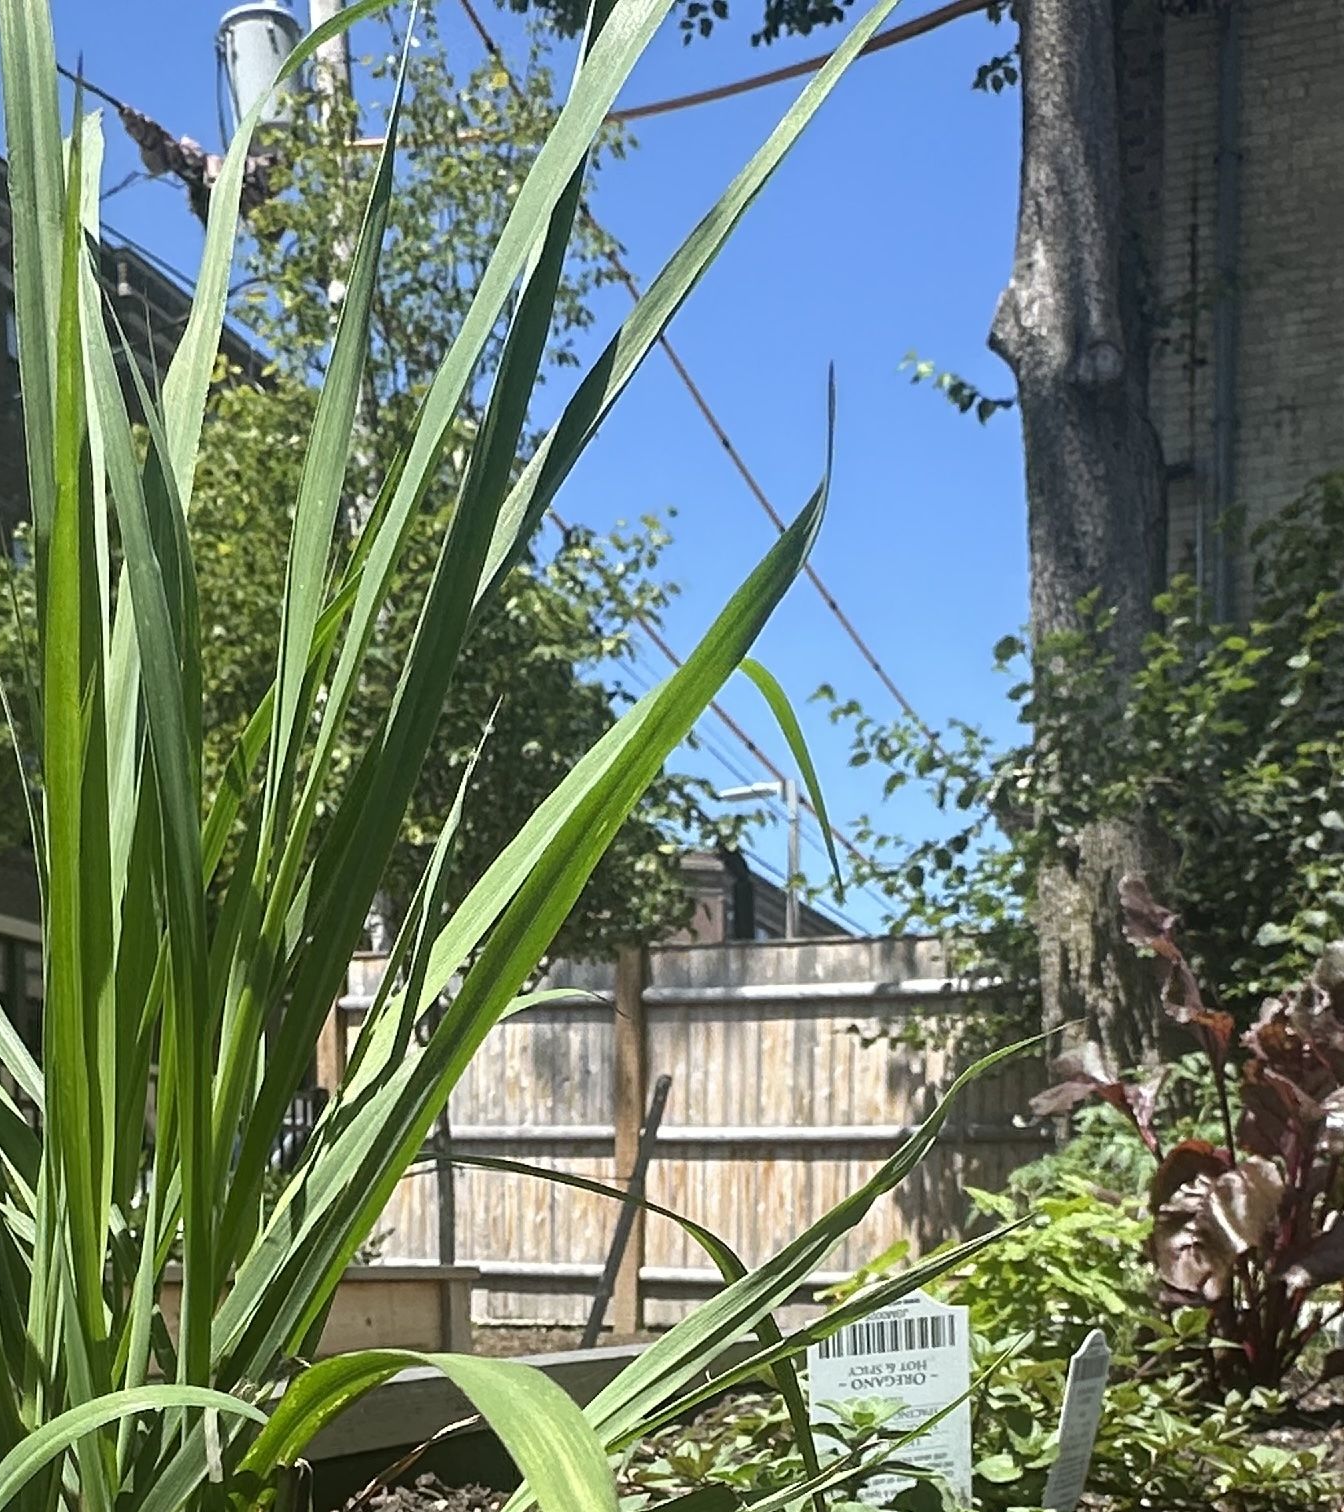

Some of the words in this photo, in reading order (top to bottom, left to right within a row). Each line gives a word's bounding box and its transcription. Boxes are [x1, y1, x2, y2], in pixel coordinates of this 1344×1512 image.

[849, 1364, 883, 1376] SPICY
[885, 1363, 896, 1373] &
[900, 1360, 927, 1373] HOT
[851, 1373, 926, 1390] OREGANO
